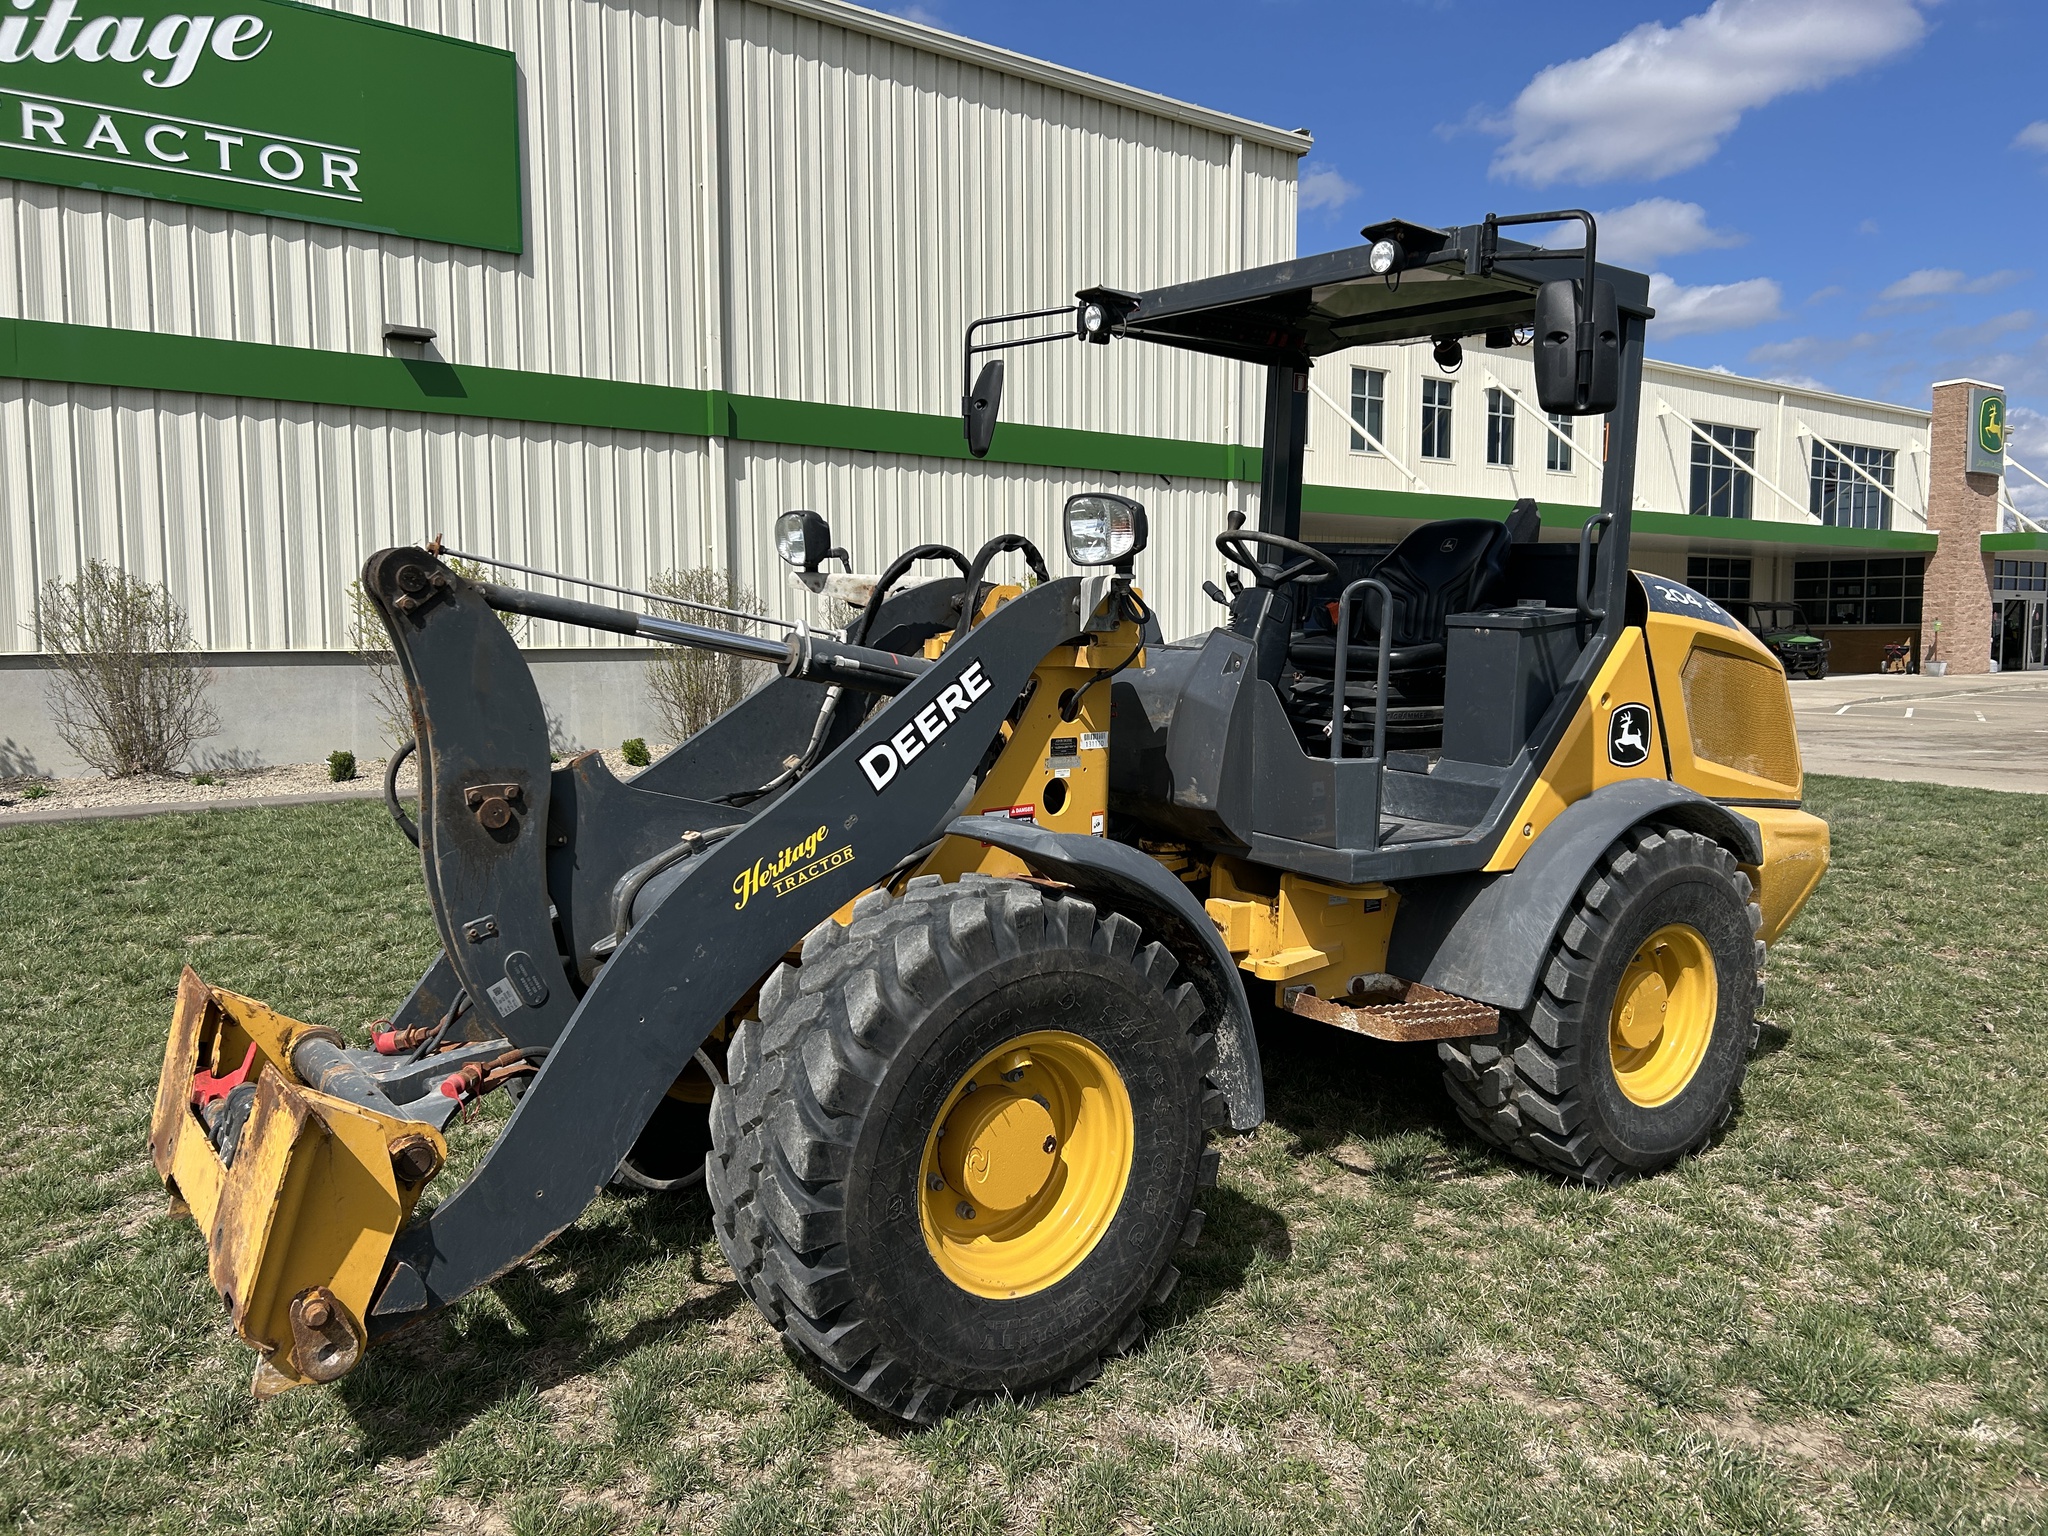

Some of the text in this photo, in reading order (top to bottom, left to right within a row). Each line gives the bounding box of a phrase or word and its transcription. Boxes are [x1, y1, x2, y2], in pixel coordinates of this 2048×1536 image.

[20, 101, 361, 193] RACTOR
[1654, 585, 1702, 609] 204
[859, 660, 992, 792] DEERE
[1015, 806, 1034, 814] DANGER
[732, 824, 829, 911] Heritage
[773, 847, 855, 893] TRACTOR
